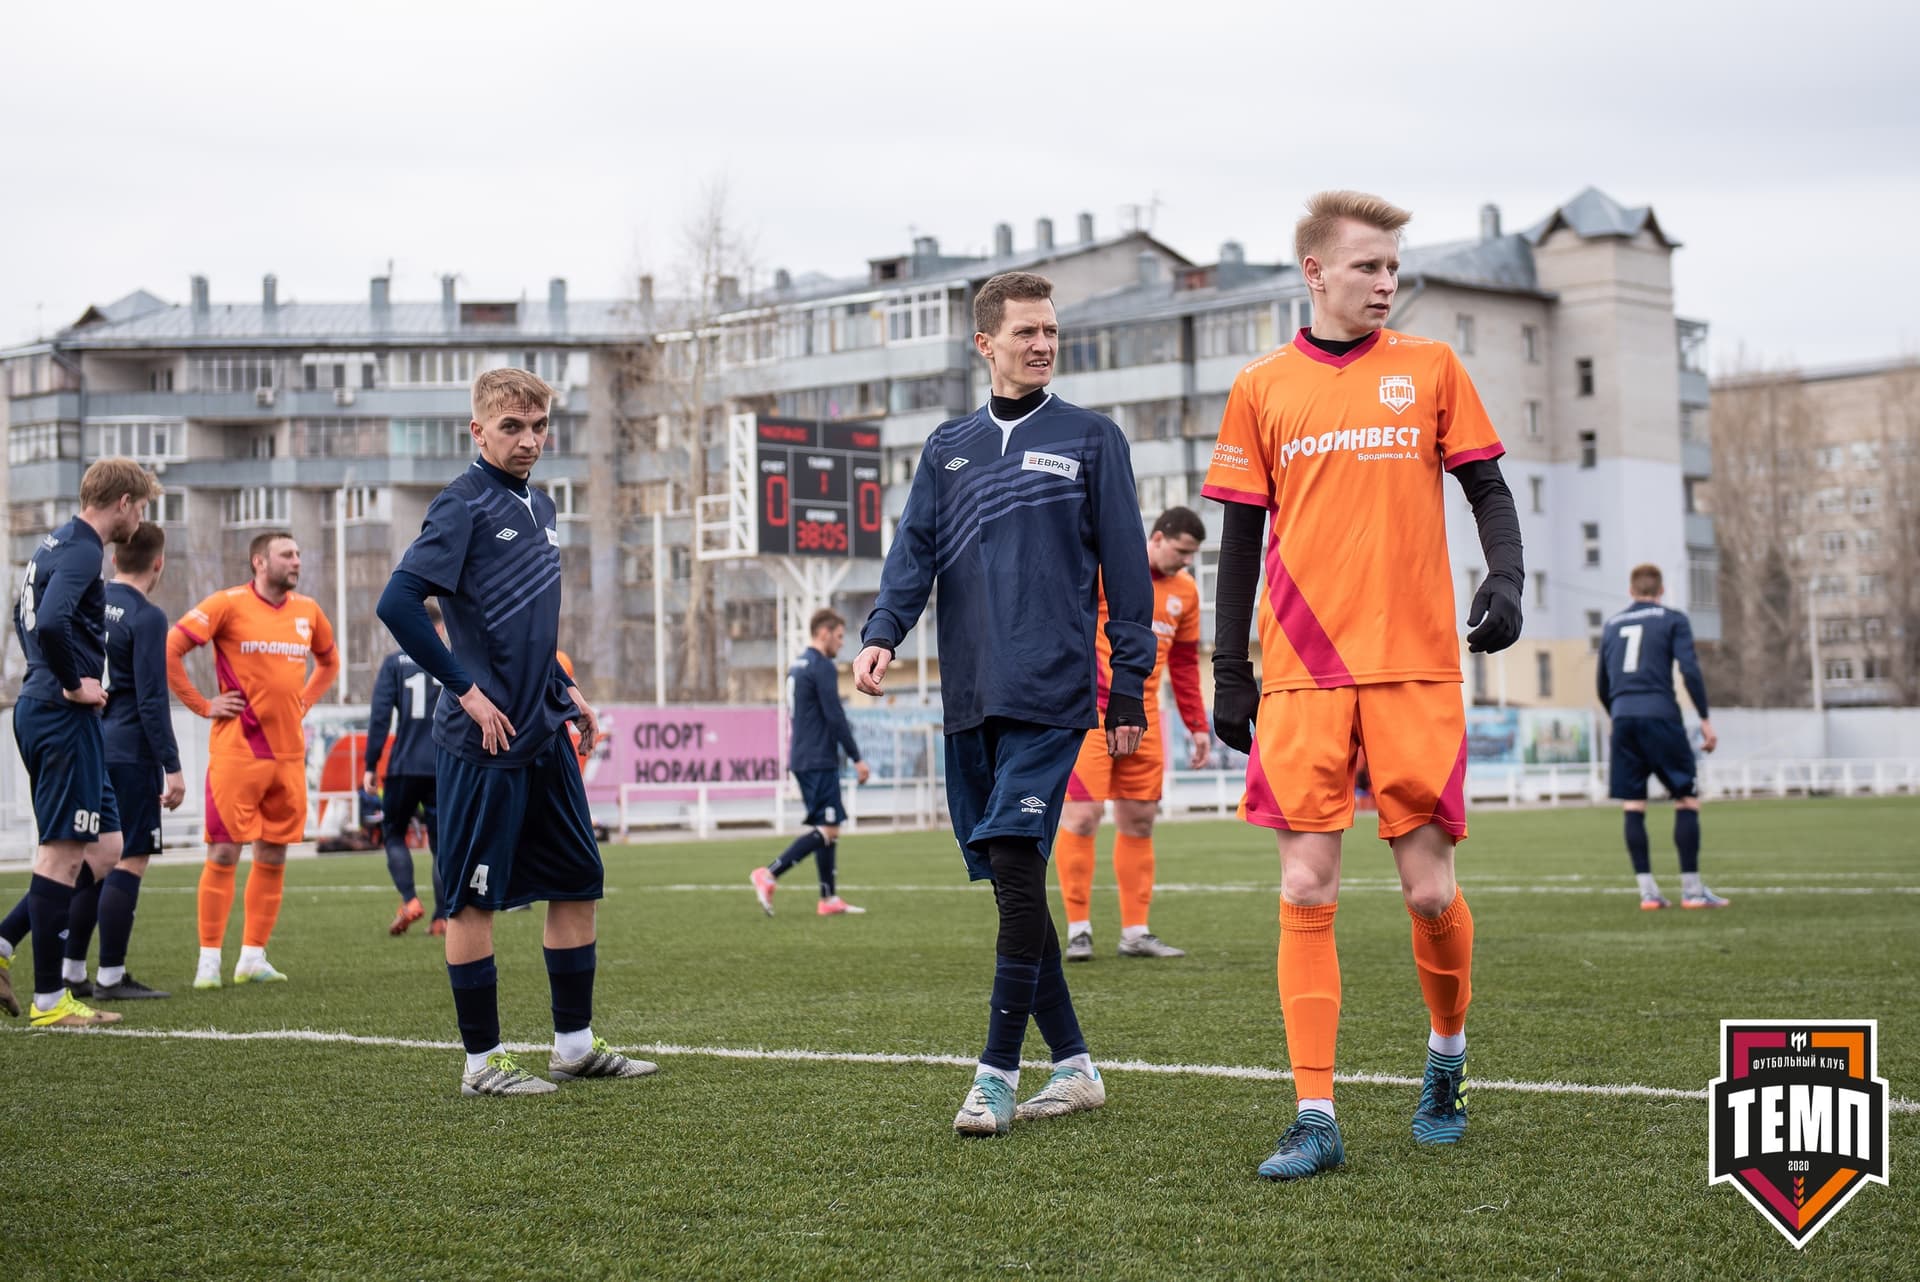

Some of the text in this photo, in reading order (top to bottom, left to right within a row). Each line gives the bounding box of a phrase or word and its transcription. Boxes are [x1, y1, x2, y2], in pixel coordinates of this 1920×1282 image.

[1382, 385, 1413, 400] ТЕМП
[1212, 452, 1249, 466] оление
[1281, 426, 1420, 468] ПРОДИНВЕСТ
[1357, 452, 1403, 462] Бродников
[1037, 458, 1071, 472] ЕВРАЗ
[766, 475, 789, 527] 0
[858, 481, 880, 532] 0
[797, 521, 848, 551] 38:05
[1619, 624, 1643, 673] 7
[635, 757, 780, 783] НОРМА ЖИЗ
[469, 863, 489, 896] 4
